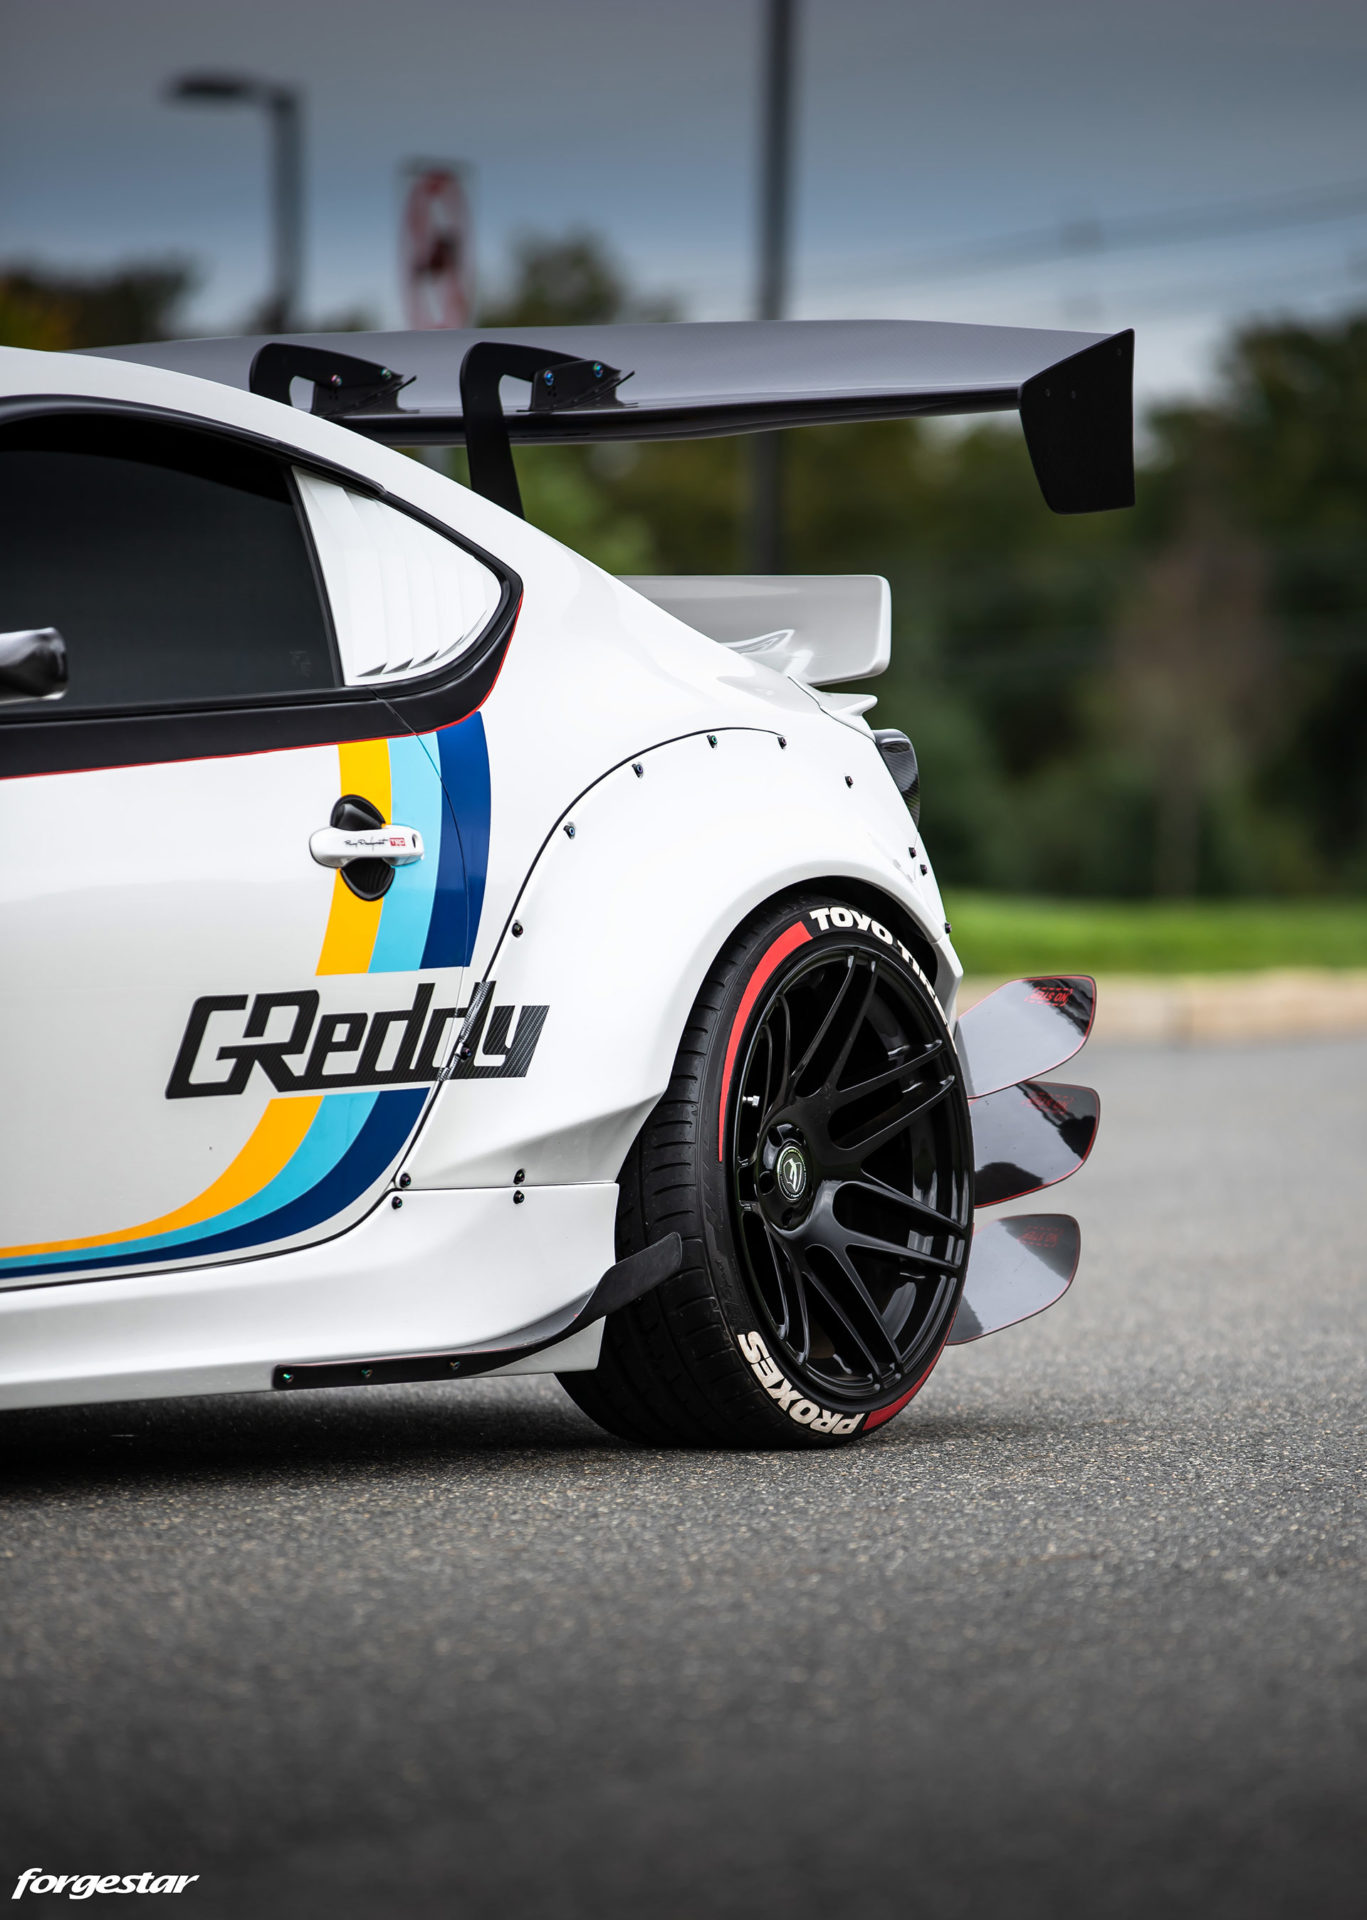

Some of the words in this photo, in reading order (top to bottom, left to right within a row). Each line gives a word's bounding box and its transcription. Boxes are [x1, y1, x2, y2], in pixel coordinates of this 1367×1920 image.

[809, 906, 893, 945] TOYO
[165, 980, 550, 1099] GReddy
[737, 1330, 865, 1434] PROXES
